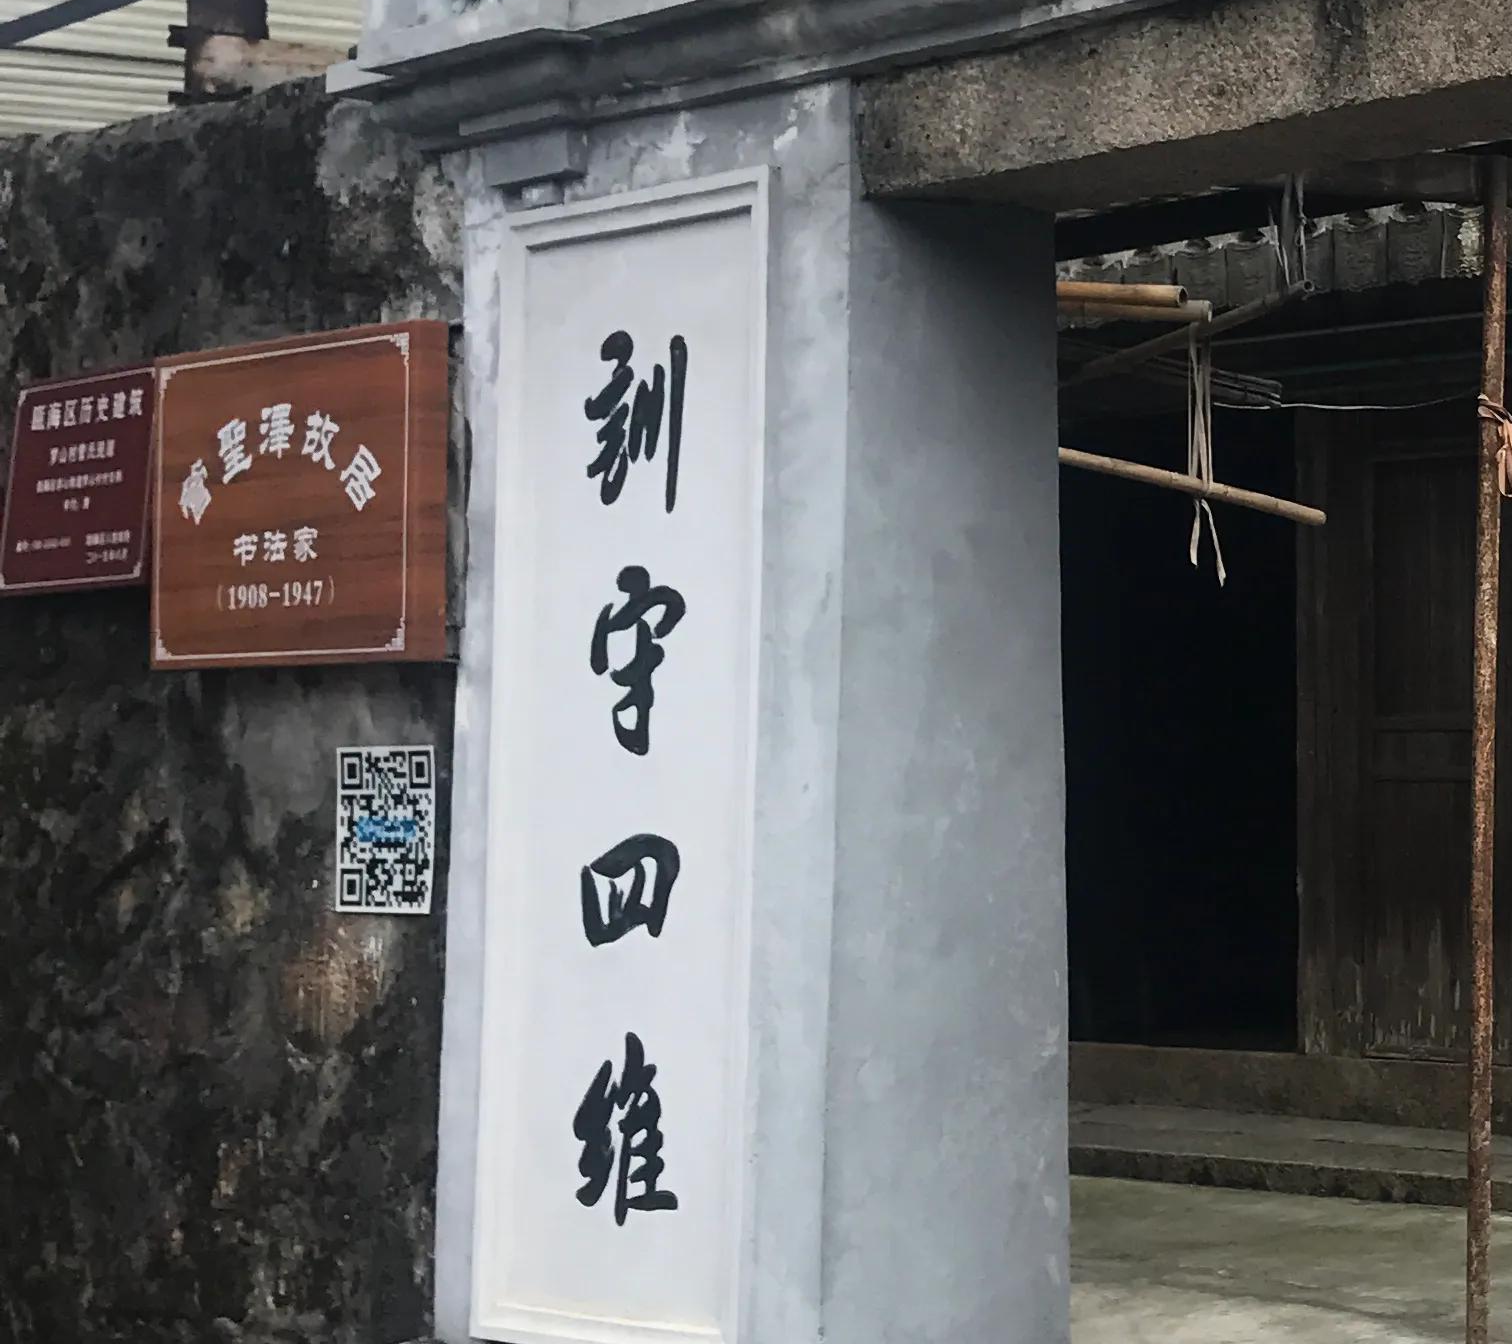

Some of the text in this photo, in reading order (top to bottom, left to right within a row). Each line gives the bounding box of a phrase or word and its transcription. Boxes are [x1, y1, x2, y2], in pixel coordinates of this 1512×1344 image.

[233, 525, 319, 567] 书法家
[216, 575, 335, 613] (1908-1947)
[572, 329, 688, 1227] 訓守四維
